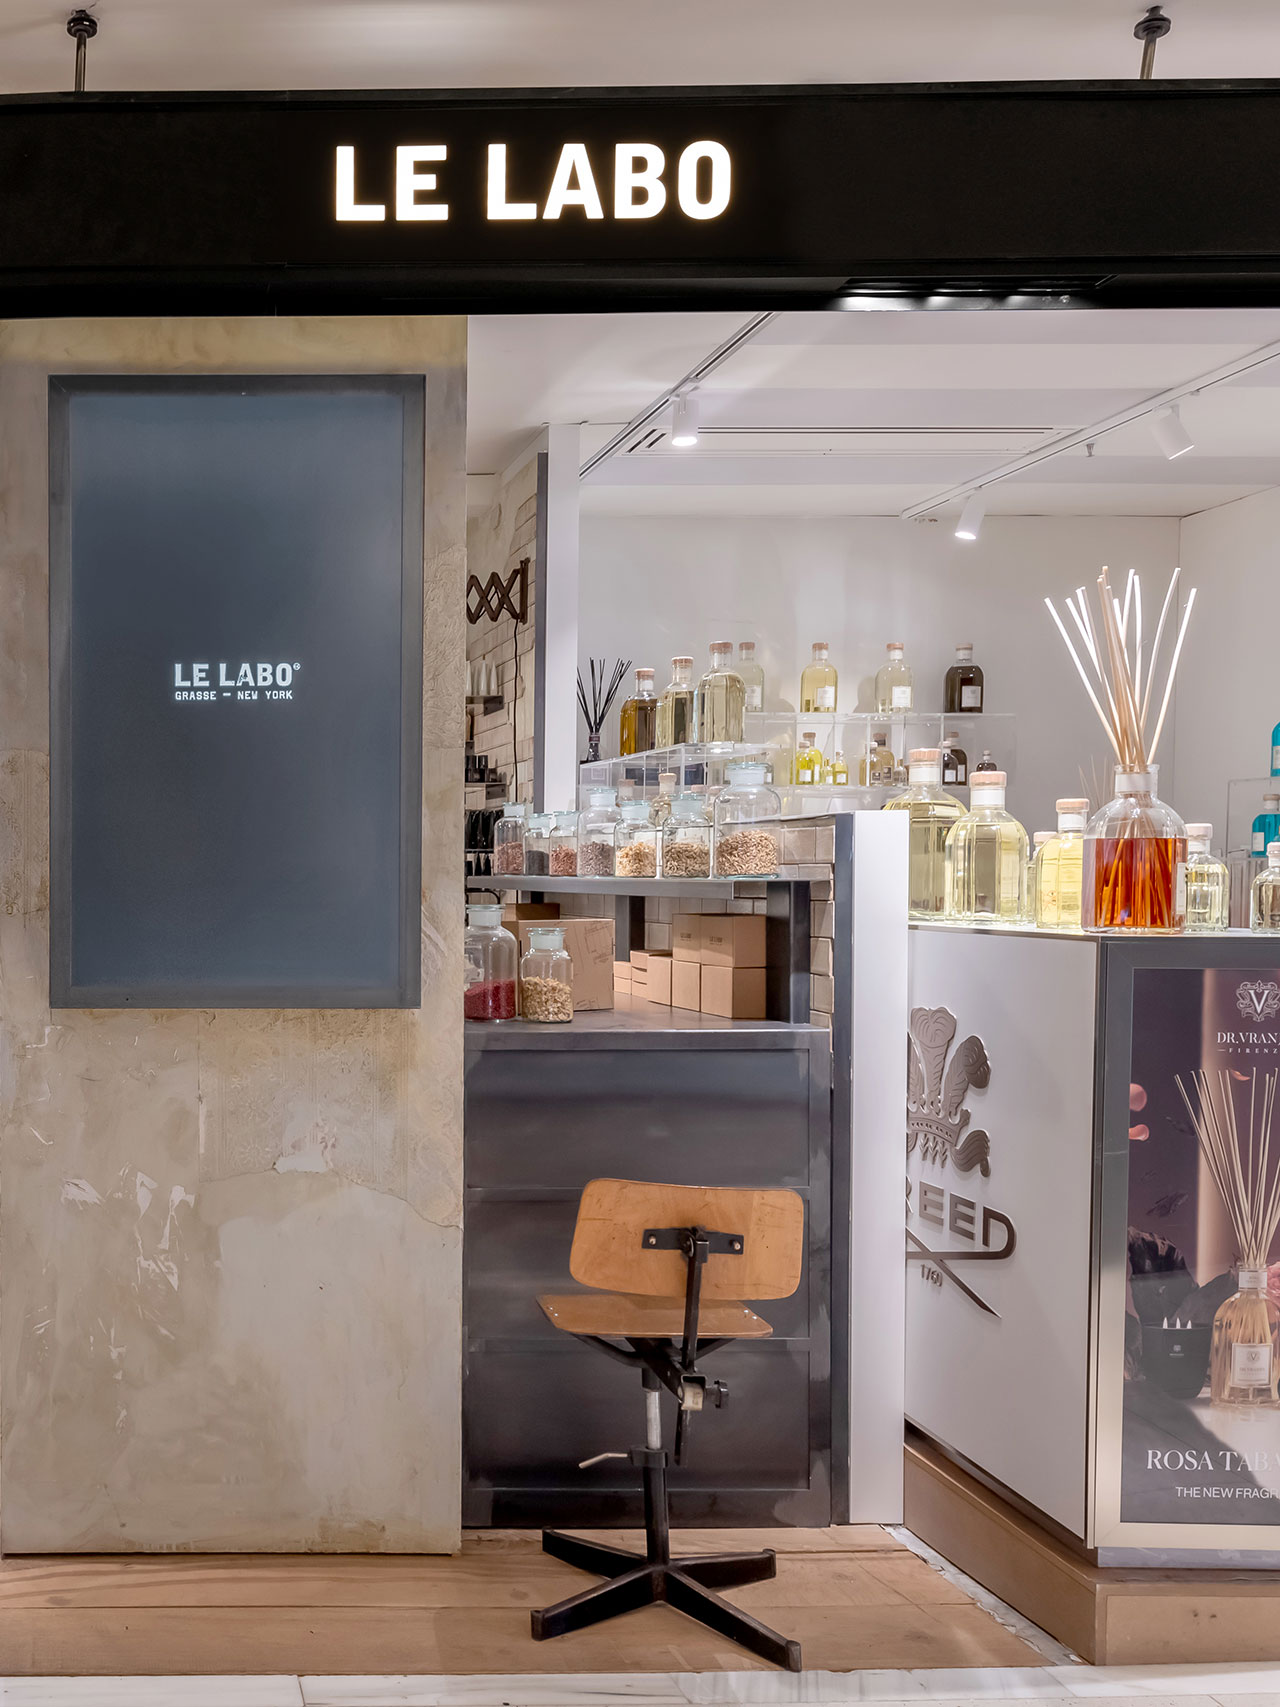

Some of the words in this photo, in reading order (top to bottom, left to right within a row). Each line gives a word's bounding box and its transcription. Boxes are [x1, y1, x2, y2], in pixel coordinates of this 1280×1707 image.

[336, 145, 448, 221] LE
[487, 140, 731, 220] LABO
[175, 663, 210, 687] LE
[175, 691, 217, 700] GRASSE
[237, 690, 258, 700] NEW
[265, 690, 293, 700] YORK
[1217, 1031, 1280, 1046] DR.VRAN
[1146, 1449, 1214, 1471] ROSA
[1175, 1486, 1201, 1498] THE
[1202, 1487, 1234, 1499] NEW
